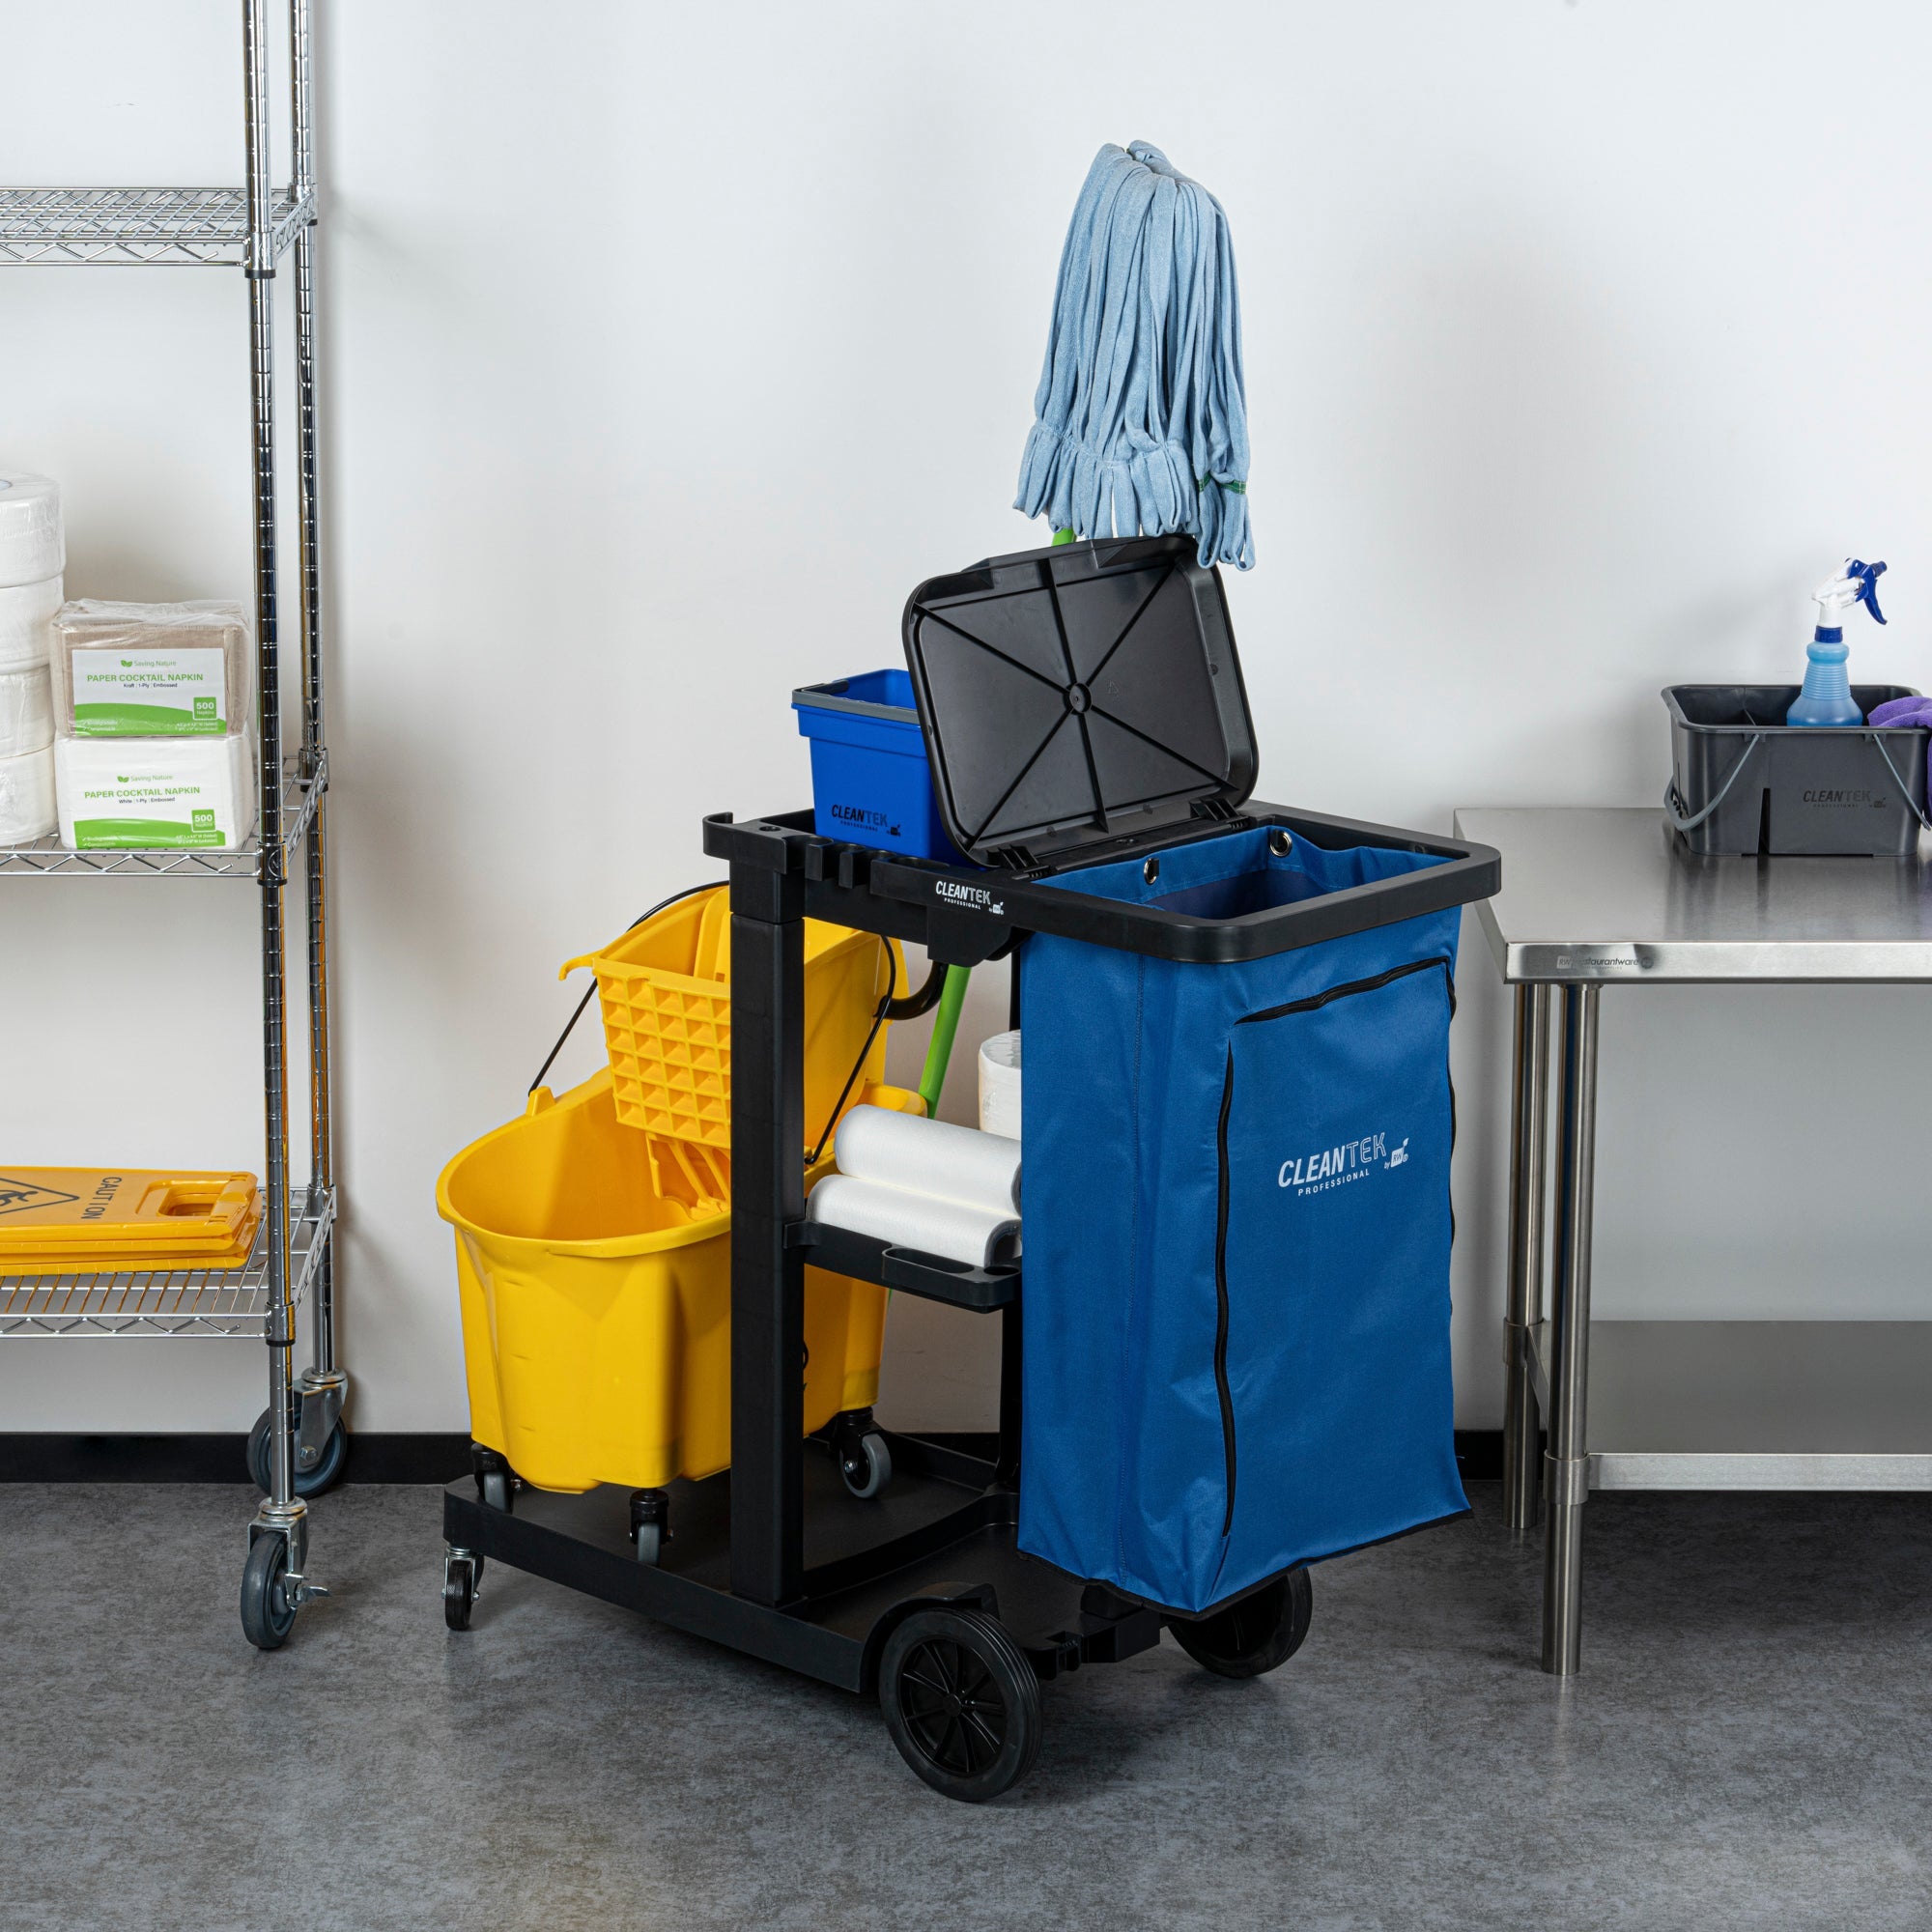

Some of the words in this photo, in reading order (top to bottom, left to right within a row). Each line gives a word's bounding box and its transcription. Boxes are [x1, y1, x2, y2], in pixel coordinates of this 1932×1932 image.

[84, 790, 114, 799] PAPER
[116, 788, 162, 798] COCKTAIL
[165, 786, 201, 795] NAPKIN
[1803, 790, 1871, 803] CLEANTEK
[832, 804, 888, 827] CLEANTEK
[935, 880, 991, 905] CLEANTEK
[944, 897, 981, 910] PROFESSIONAL
[1278, 1131, 1387, 1187] CLEANTEK
[1297, 1168, 1370, 1197] PROFESSIONAL
[80, 1177, 123, 1219] CAUTION
